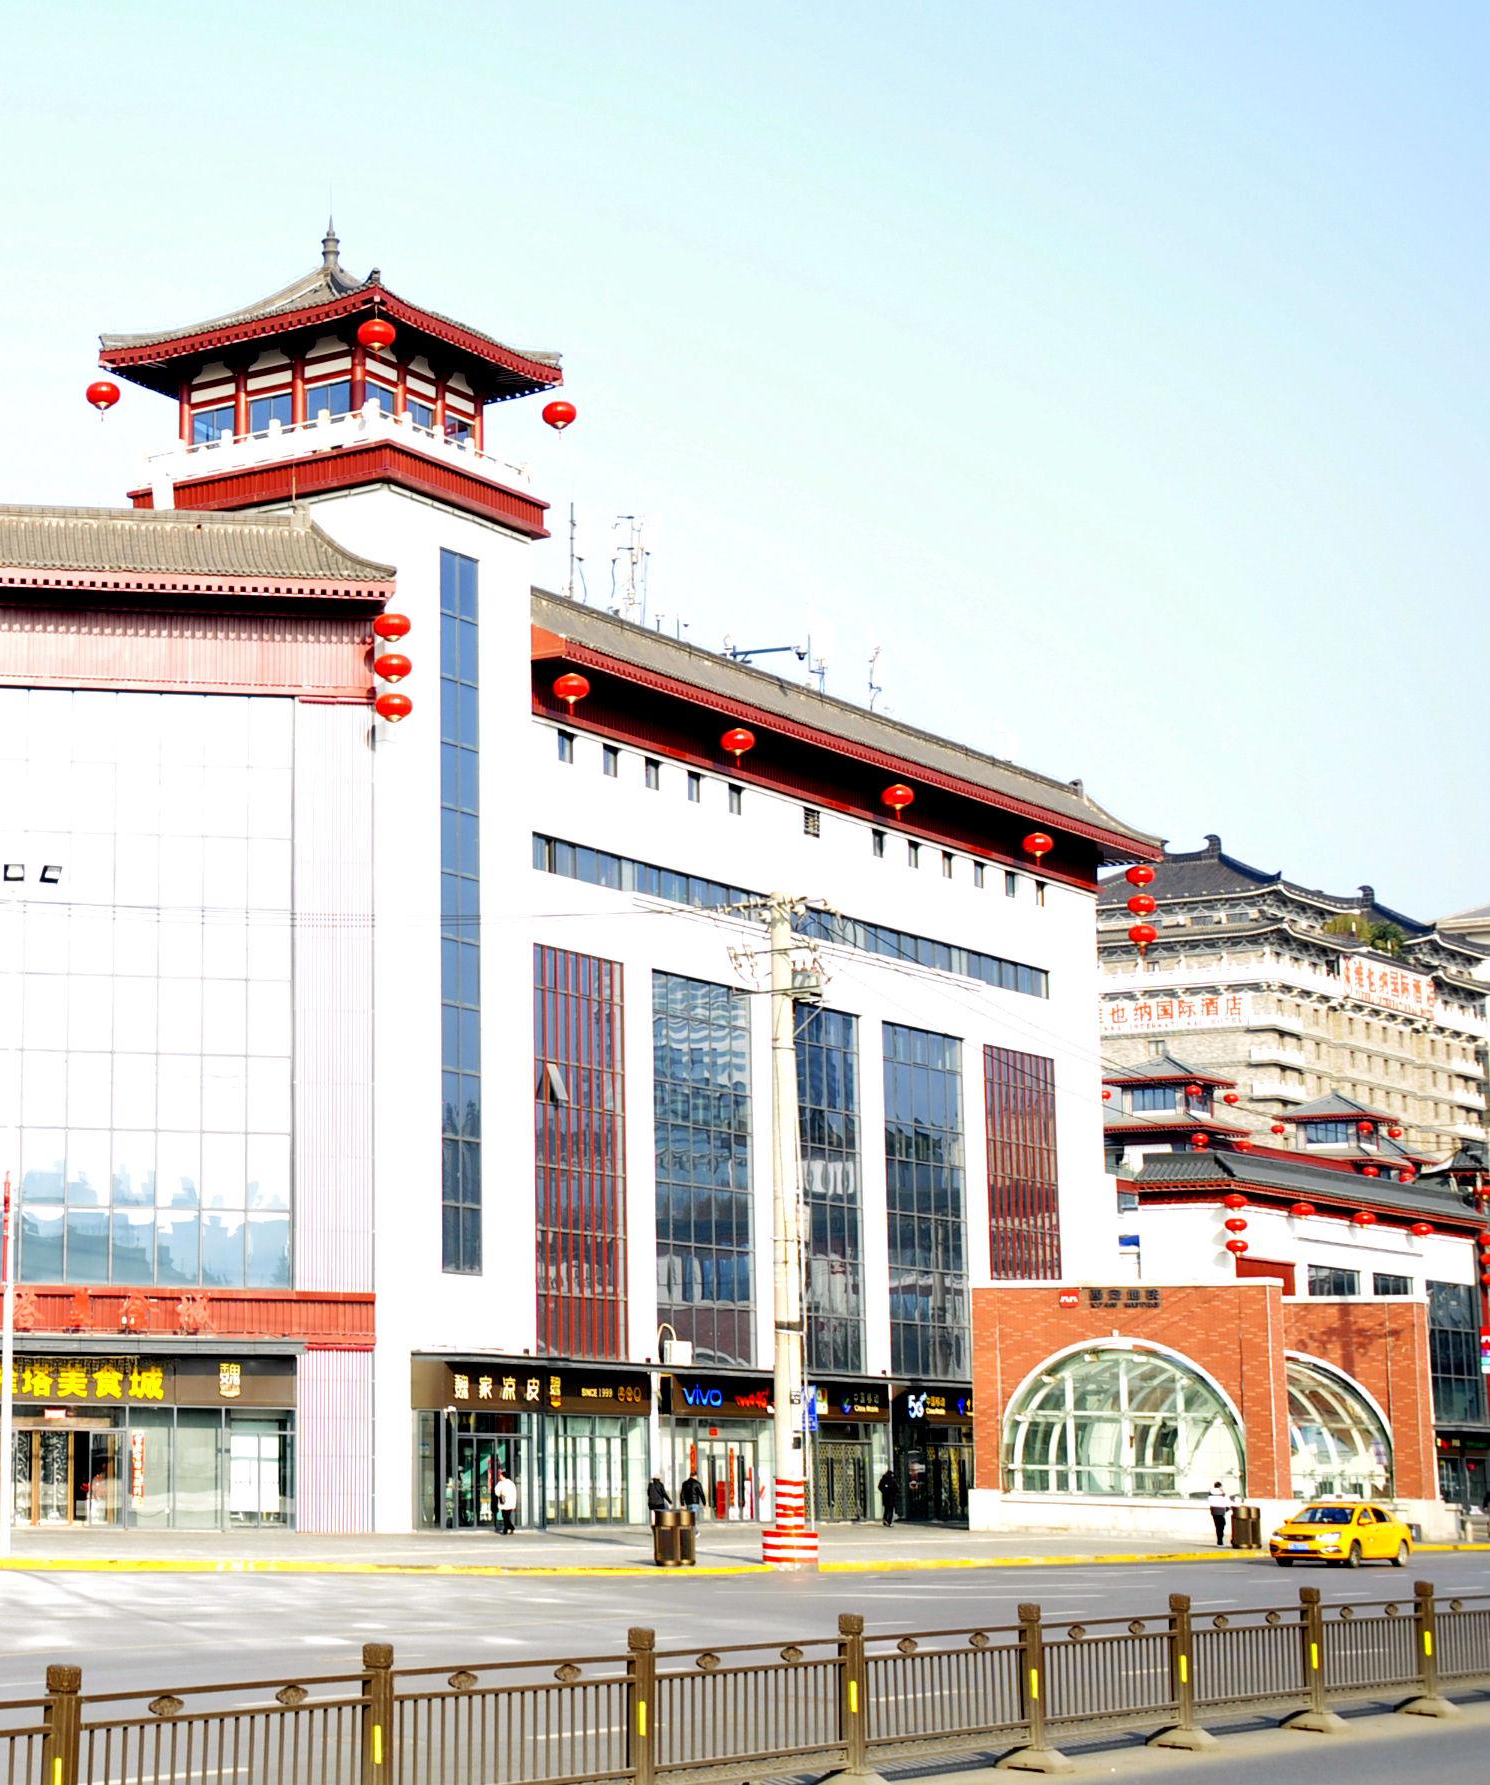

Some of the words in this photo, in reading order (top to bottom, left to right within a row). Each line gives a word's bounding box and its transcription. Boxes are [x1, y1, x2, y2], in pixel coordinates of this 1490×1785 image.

[454, 1374, 540, 1401] 魏家凉皮
[682, 1384, 723, 1407] vivo
[908, 1393, 925, 1418] 5G
